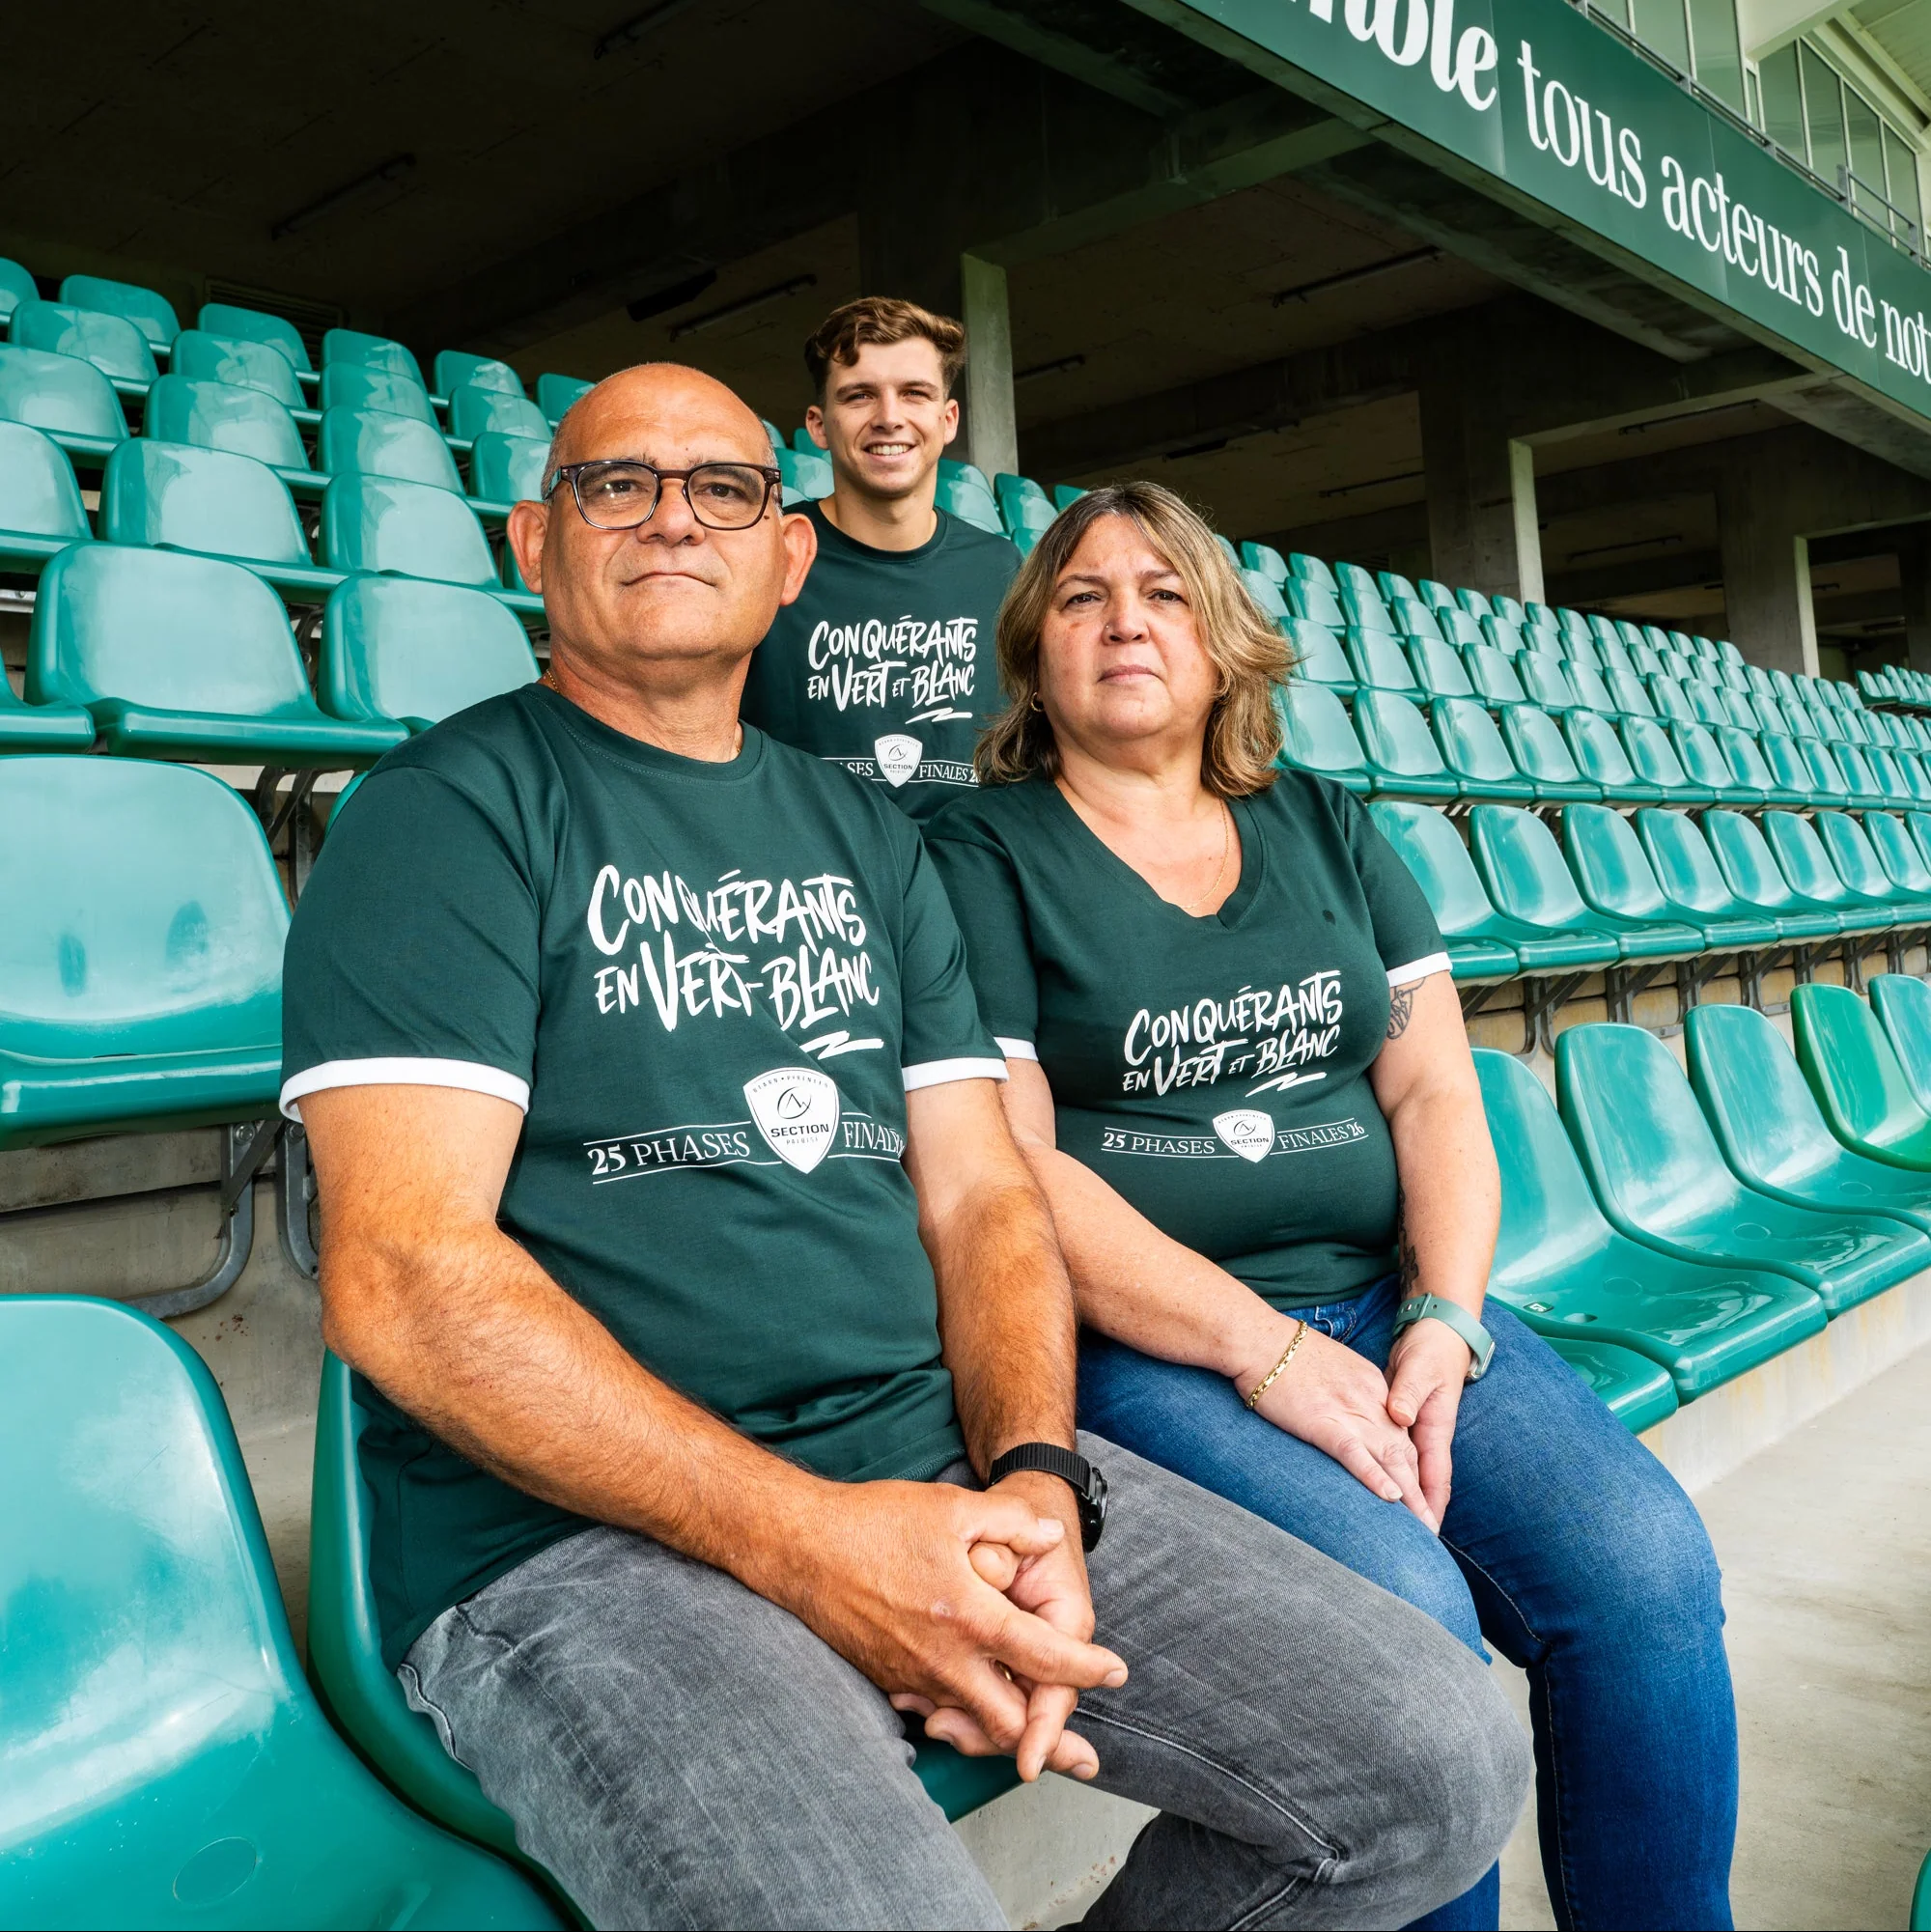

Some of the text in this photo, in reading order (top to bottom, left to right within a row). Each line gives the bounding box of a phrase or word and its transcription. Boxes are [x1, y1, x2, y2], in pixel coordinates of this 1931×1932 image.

[1517, 41, 1647, 210] tous
[1661, 155, 1824, 318] acteurs
[1832, 245, 1877, 349] de
[807, 615, 979, 671] CONQUÉRANTS
[807, 657, 975, 713] EN VERT ET BLANC
[918, 764, 967, 782] FINALES
[593, 930, 881, 1033] EN VERT BLANC
[1123, 969, 1343, 1067] CONQUÉRANTS
[1122, 1024, 1341, 1097] EN VERT ET BLANC
[587, 1143, 627, 1176] 25
[630, 1131, 751, 1167] PHASES
[770, 1123, 829, 1138] SECTION
[1102, 1121, 1365, 1155] 25 PHASES FINALES 26
[1230, 1137, 1270, 1146] SECTION
